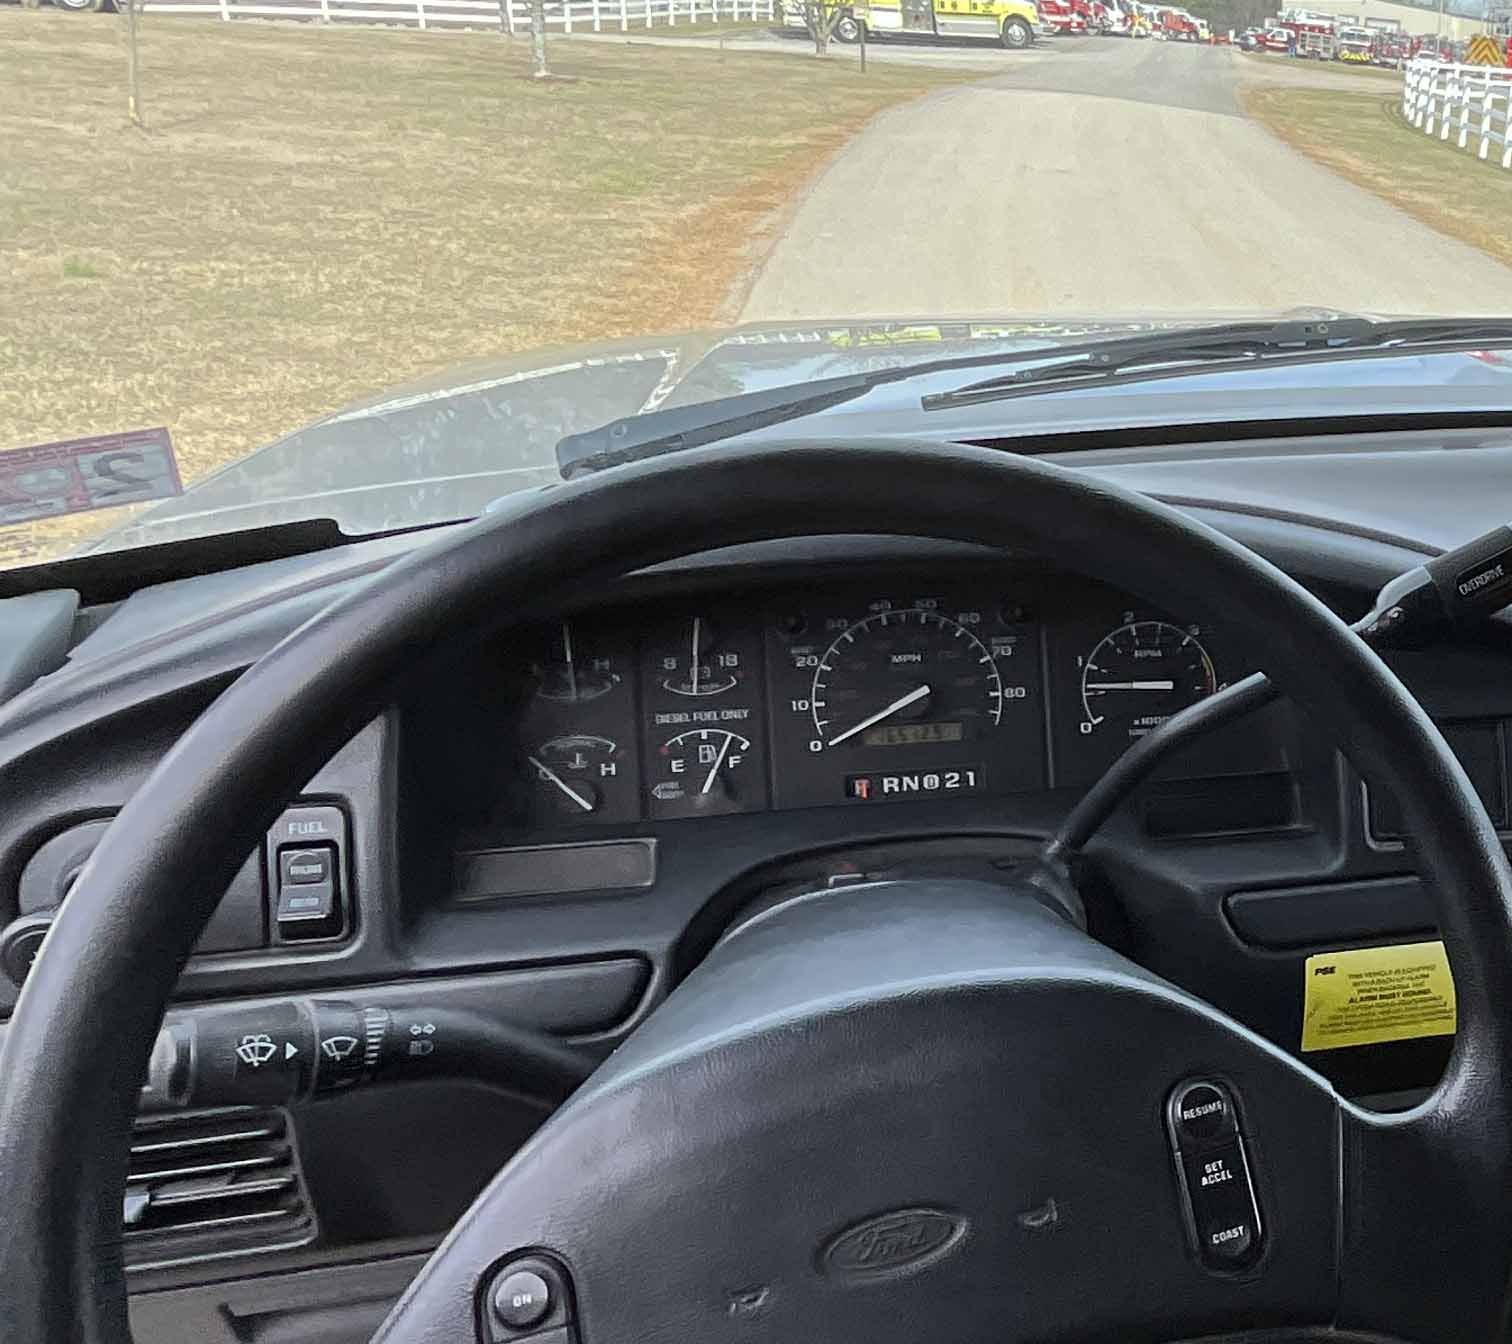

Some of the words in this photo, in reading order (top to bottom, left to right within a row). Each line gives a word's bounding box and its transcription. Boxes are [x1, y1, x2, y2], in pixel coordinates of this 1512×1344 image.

[1458, 564, 1505, 596] OVERDRIVE
[718, 654, 739, 667] 18
[796, 655, 819, 668] 20
[891, 654, 922, 663] MPH
[1004, 687, 1026, 699] 80
[791, 700, 809, 712] 10
[655, 712, 691, 724] DIESEL
[693, 711, 720, 722] FUEL
[721, 709, 750, 721] ONLY
[1080, 722, 1093, 734] 0
[809, 740, 823, 752] 0
[671, 760, 686, 773] E
[729, 756, 742, 769] F
[600, 763, 617, 777] H
[288, 821, 328, 834] FUEL
[1183, 1101, 1223, 1120] RESUME
[1205, 1159, 1224, 1173] SET
[1201, 1169, 1233, 1186] ACCEL
[1212, 1225, 1245, 1244] COAST
[513, 1293, 532, 1307] ON
